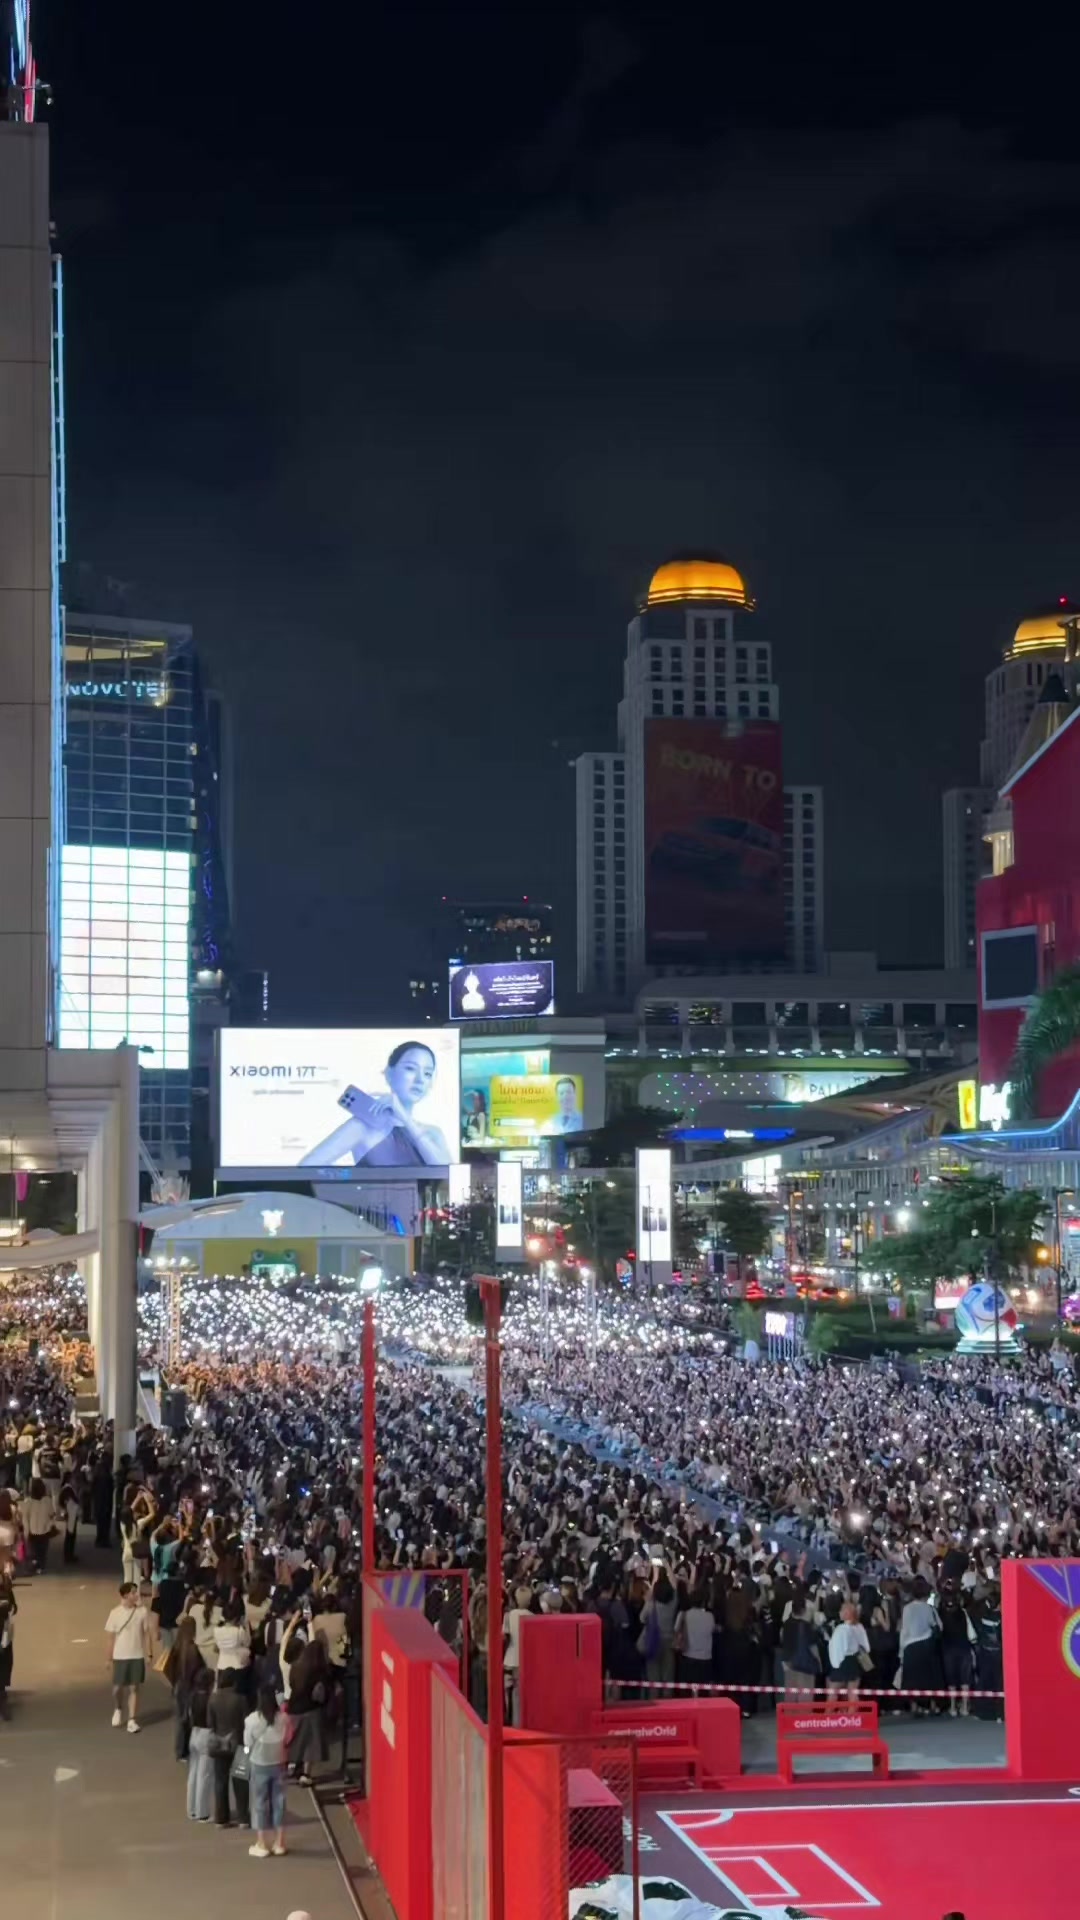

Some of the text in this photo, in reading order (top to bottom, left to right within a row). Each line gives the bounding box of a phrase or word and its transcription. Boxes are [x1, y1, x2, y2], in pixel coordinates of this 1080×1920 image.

[661, 744, 777, 791] BORN TO
[295, 1065, 317, 1079] 17T
